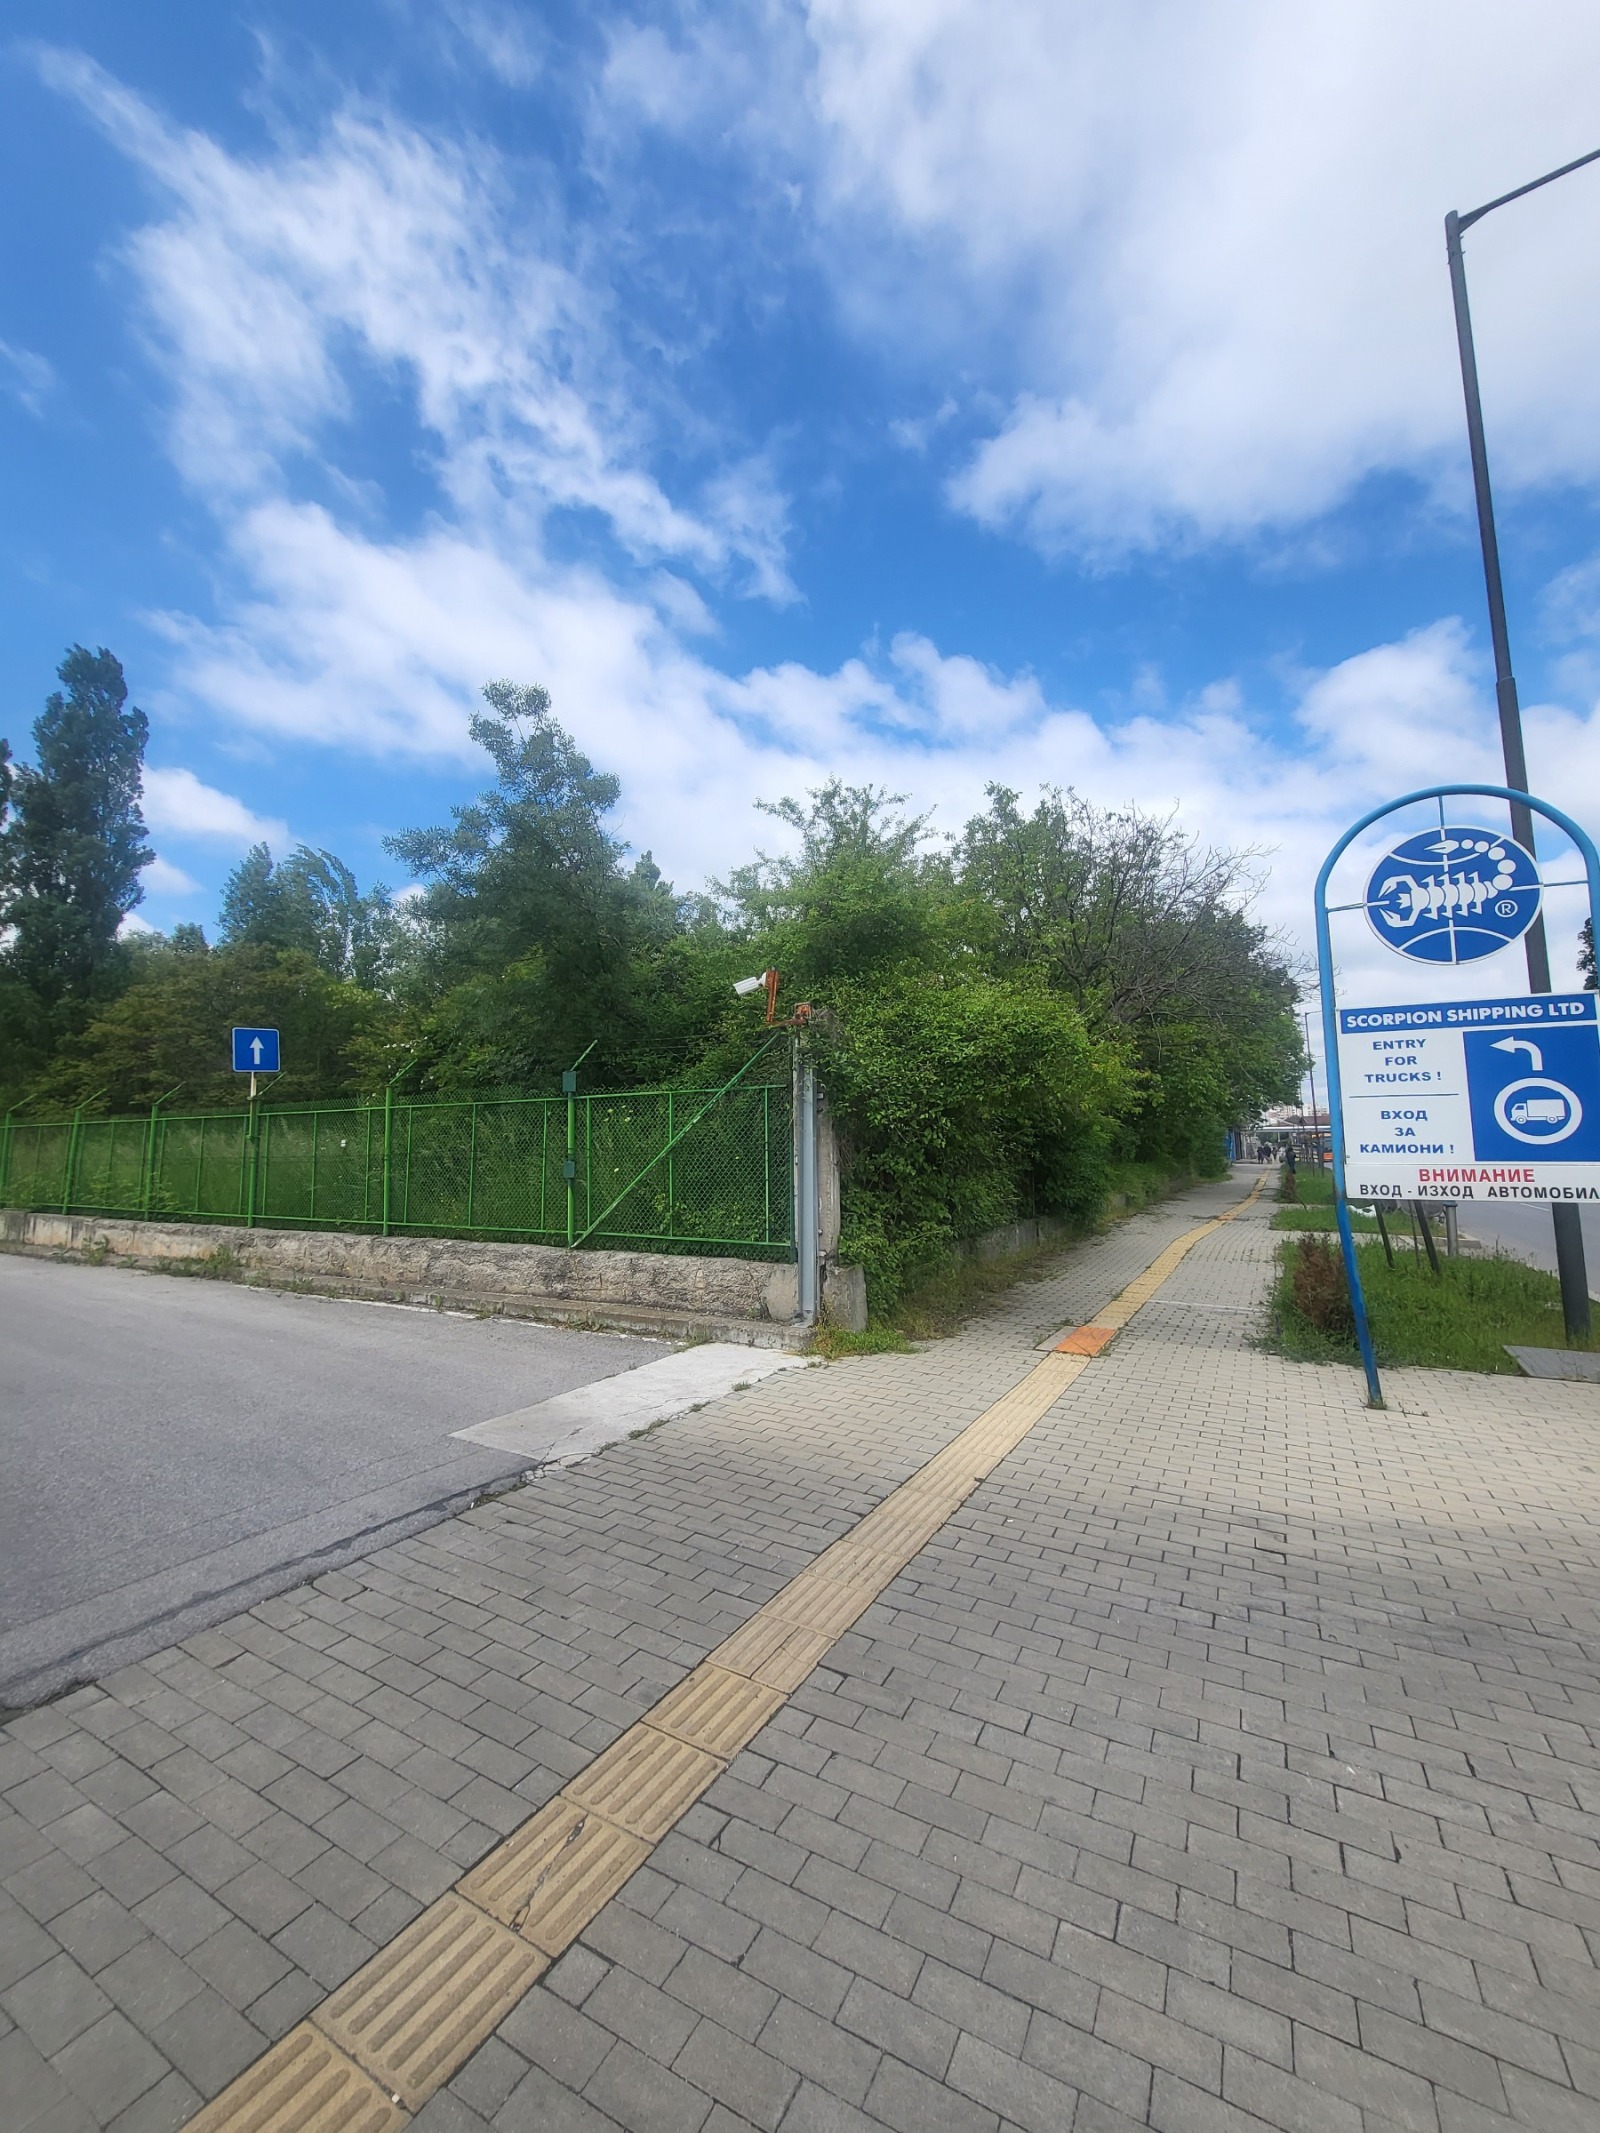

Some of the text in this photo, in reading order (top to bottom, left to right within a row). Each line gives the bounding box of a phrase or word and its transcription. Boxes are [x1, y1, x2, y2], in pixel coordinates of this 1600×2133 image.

[1346, 1002, 1585, 1027] SCORPION SHIPPING LTD
[1372, 1038, 1426, 1050] ENTRY
[1385, 1055, 1417, 1066] FOR
[1365, 1071, 1432, 1083] TRUCKS
[1381, 1109, 1428, 1122] ВХОД
[1394, 1126, 1415, 1137] ЗА
[1360, 1143, 1444, 1154] КАМИОНИ
[1419, 1168, 1535, 1183] ВНИМАНИЕ
[1360, 1184, 1403, 1198] ВХОД
[1418, 1185, 1474, 1199] ИЗХОД
[1487, 1186, 1600, 1199] АВТОМОБИЛ
